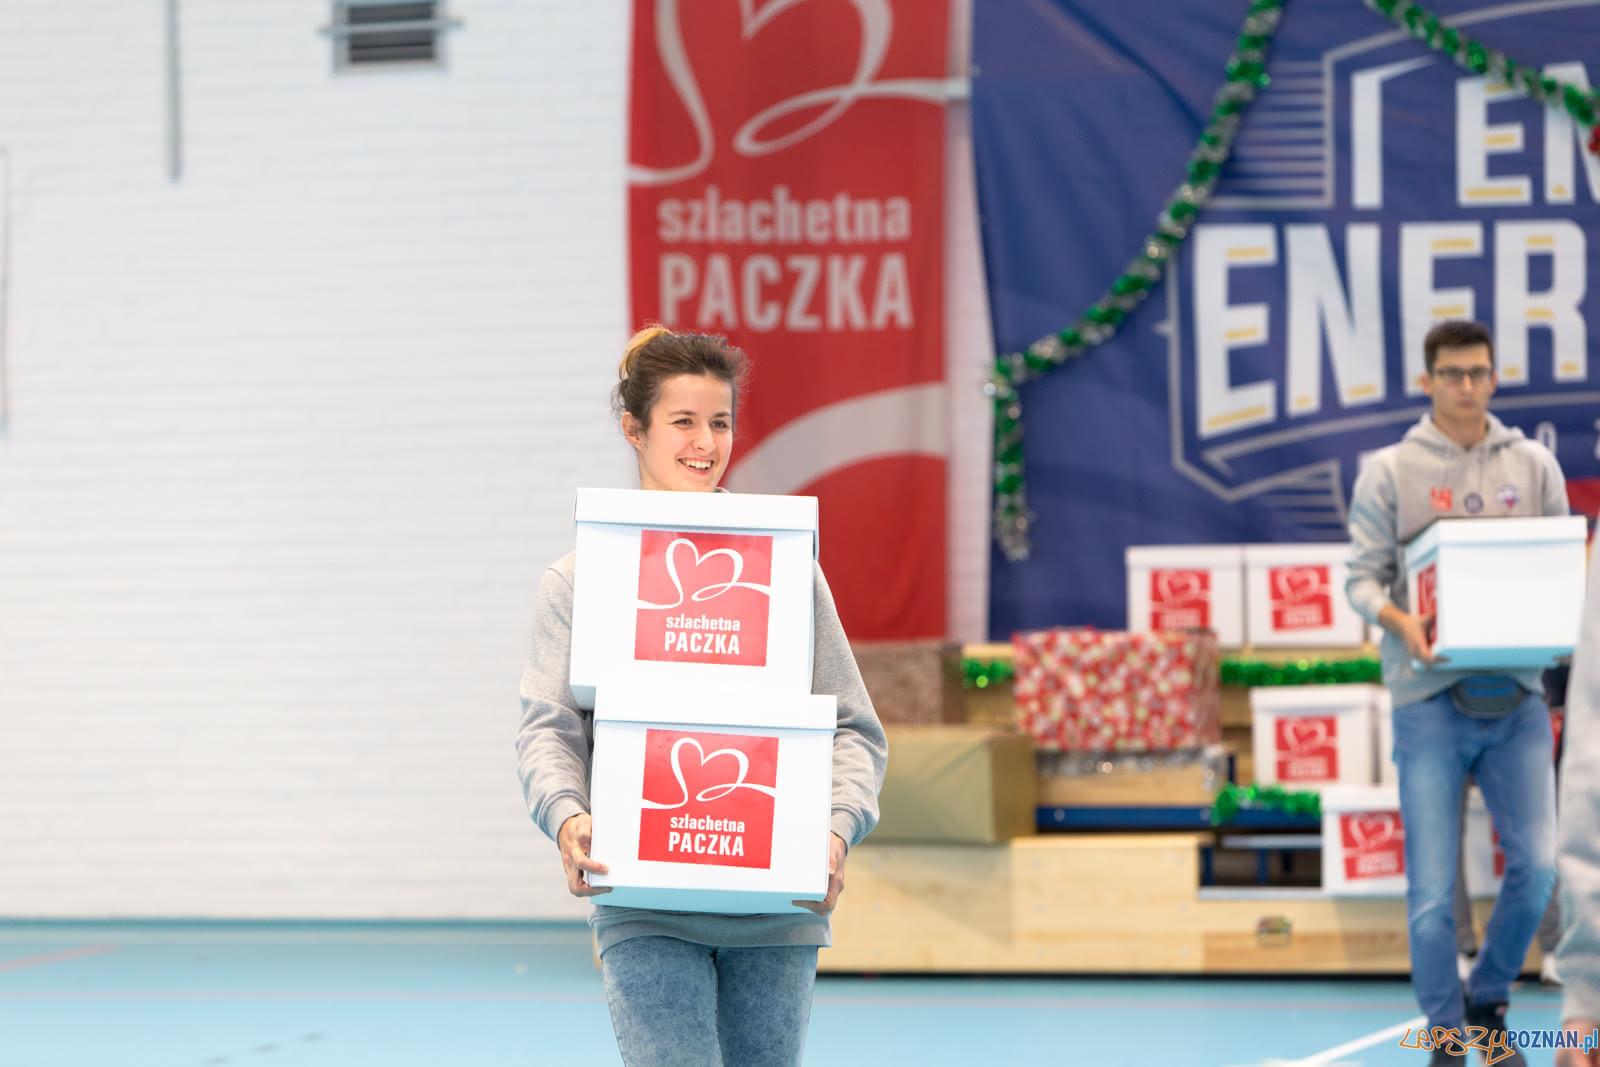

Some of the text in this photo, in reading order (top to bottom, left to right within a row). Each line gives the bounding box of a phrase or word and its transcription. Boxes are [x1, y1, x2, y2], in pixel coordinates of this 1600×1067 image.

[657, 184, 911, 243] szlachetna
[659, 252, 913, 332] PACZKA
[665, 612, 741, 632] szlachetna
[664, 630, 740, 655] PACZKA
[670, 813, 745, 833] szlachetna
[668, 831, 744, 857] PACZKA
